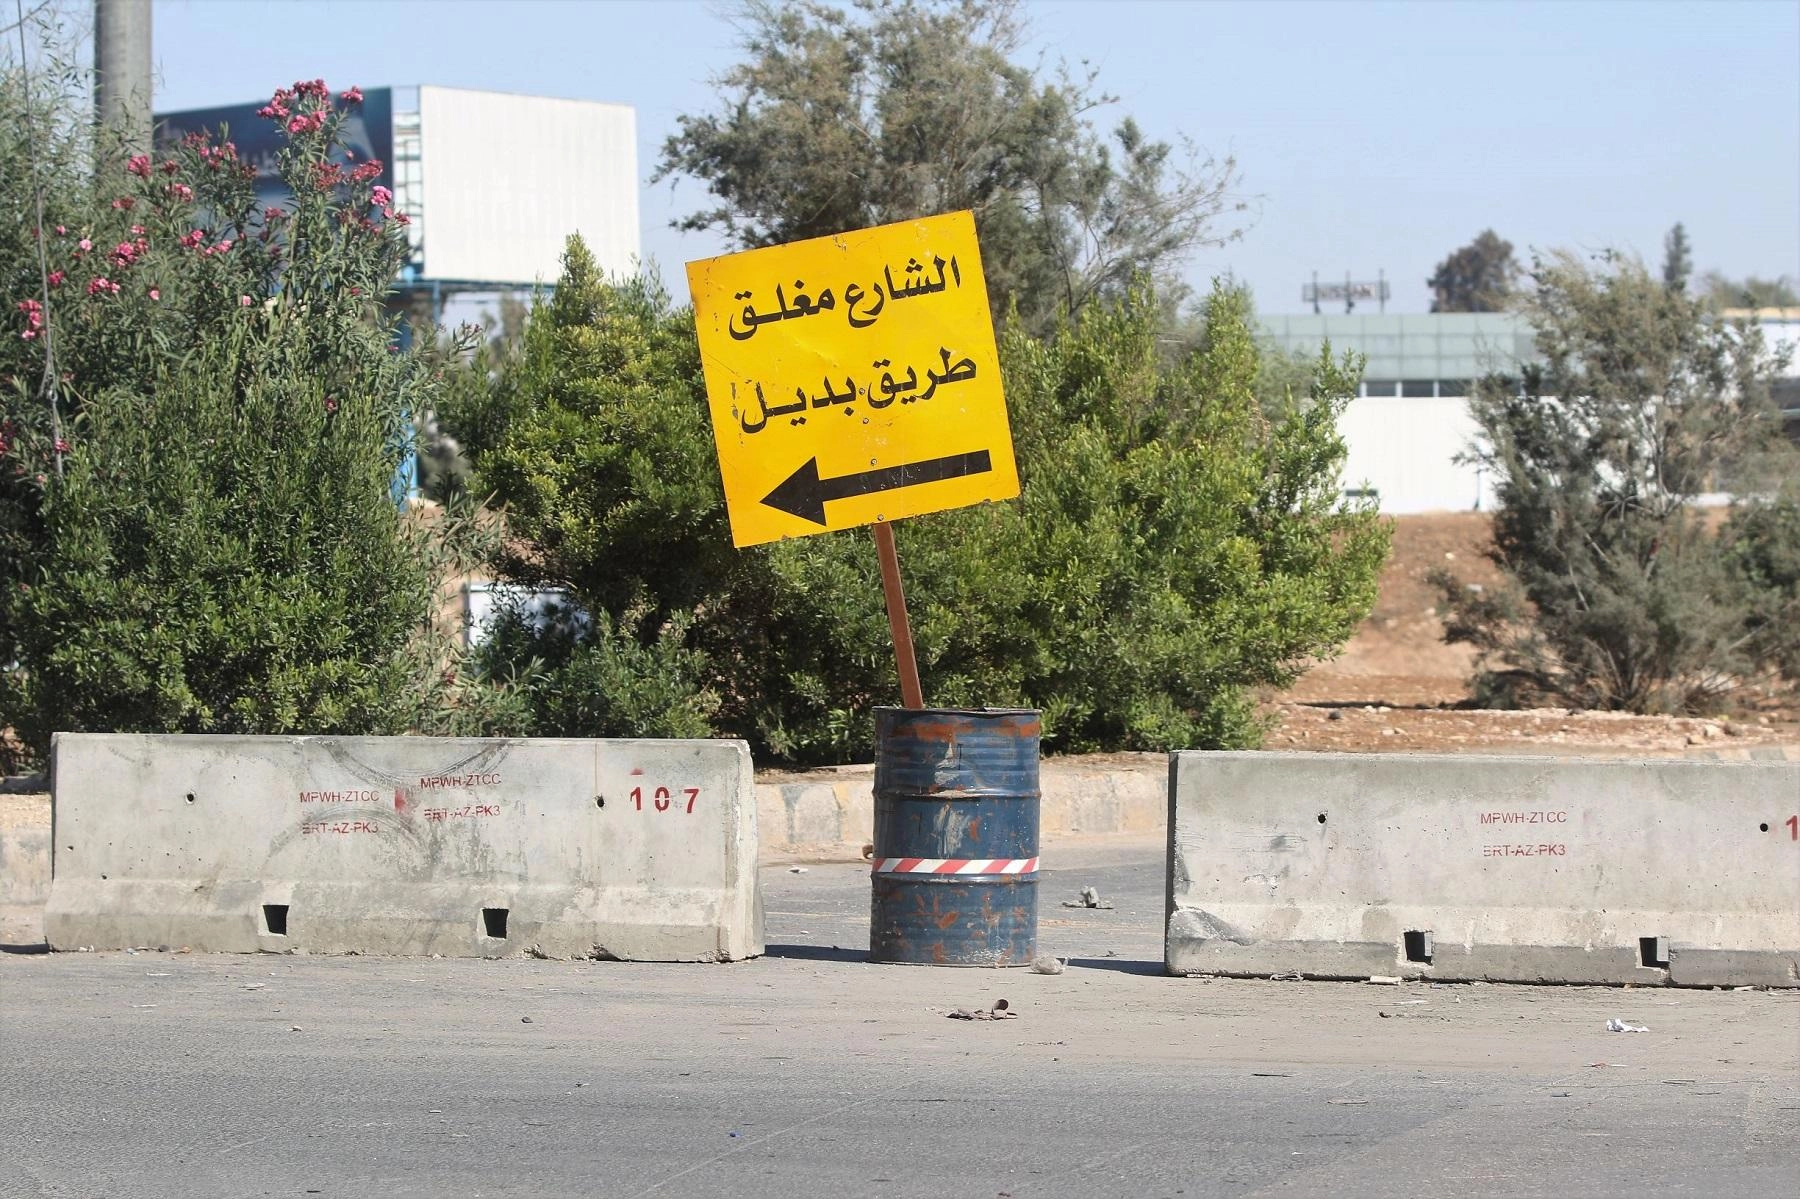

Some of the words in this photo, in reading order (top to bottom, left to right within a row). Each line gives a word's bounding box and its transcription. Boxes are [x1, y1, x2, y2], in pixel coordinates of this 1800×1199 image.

[728, 279, 836, 341] مغلق
[844, 255, 961, 328] الشارع
[741, 376, 857, 434] بديل
[867, 346, 977, 409] طريق
[630, 786, 699, 814] 107
